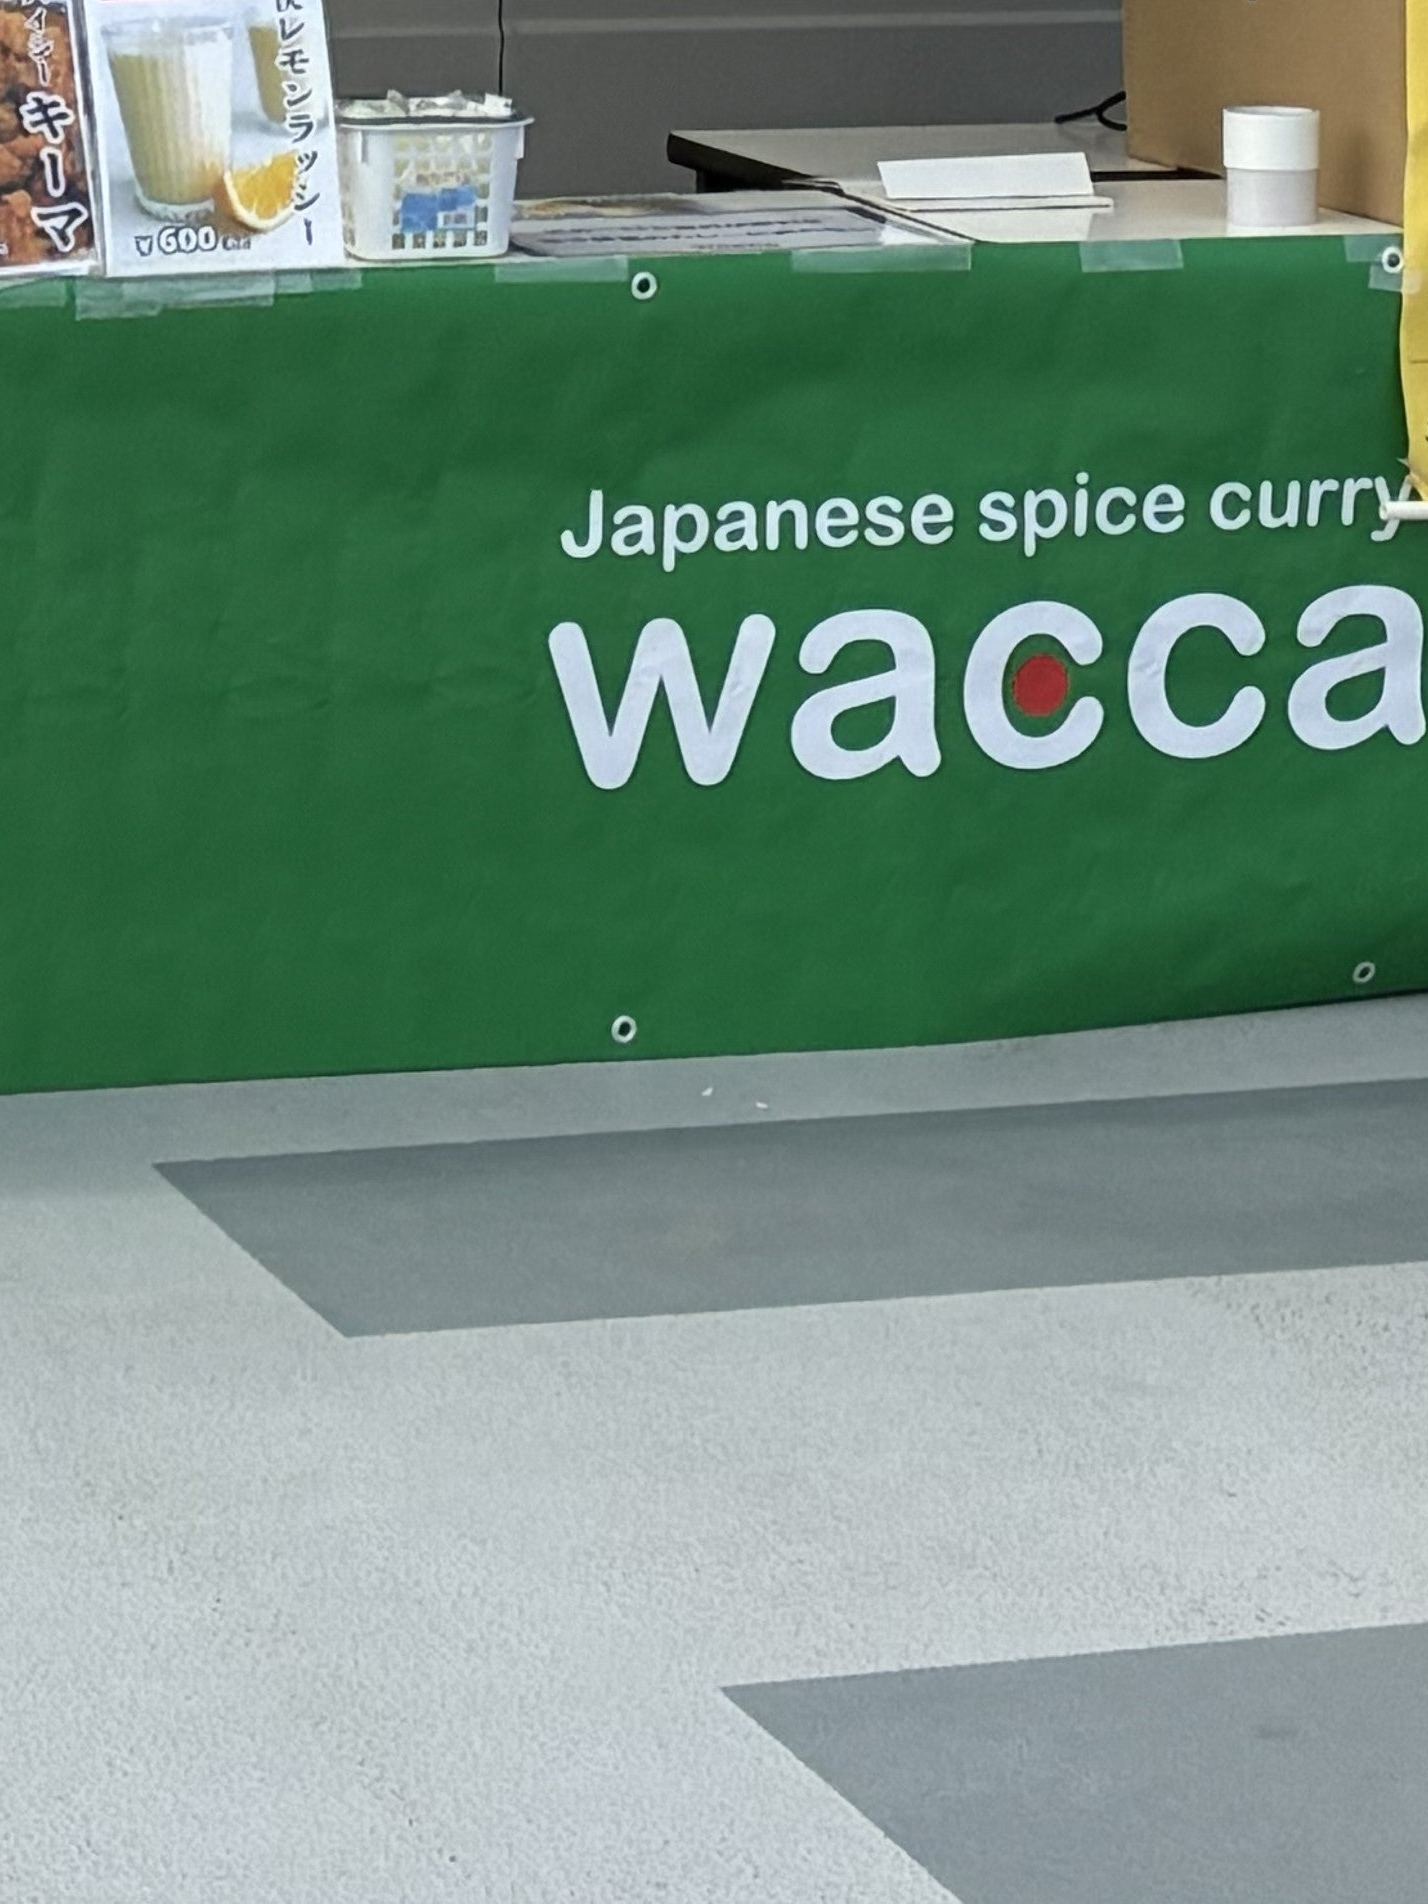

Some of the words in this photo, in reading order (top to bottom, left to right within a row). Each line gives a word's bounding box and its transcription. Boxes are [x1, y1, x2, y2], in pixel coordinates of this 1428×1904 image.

[560, 487, 955, 572] Japanese
[976, 471, 1185, 557] spice
[1208, 472, 1410, 542] curry
[547, 582, 1428, 791] wacca
